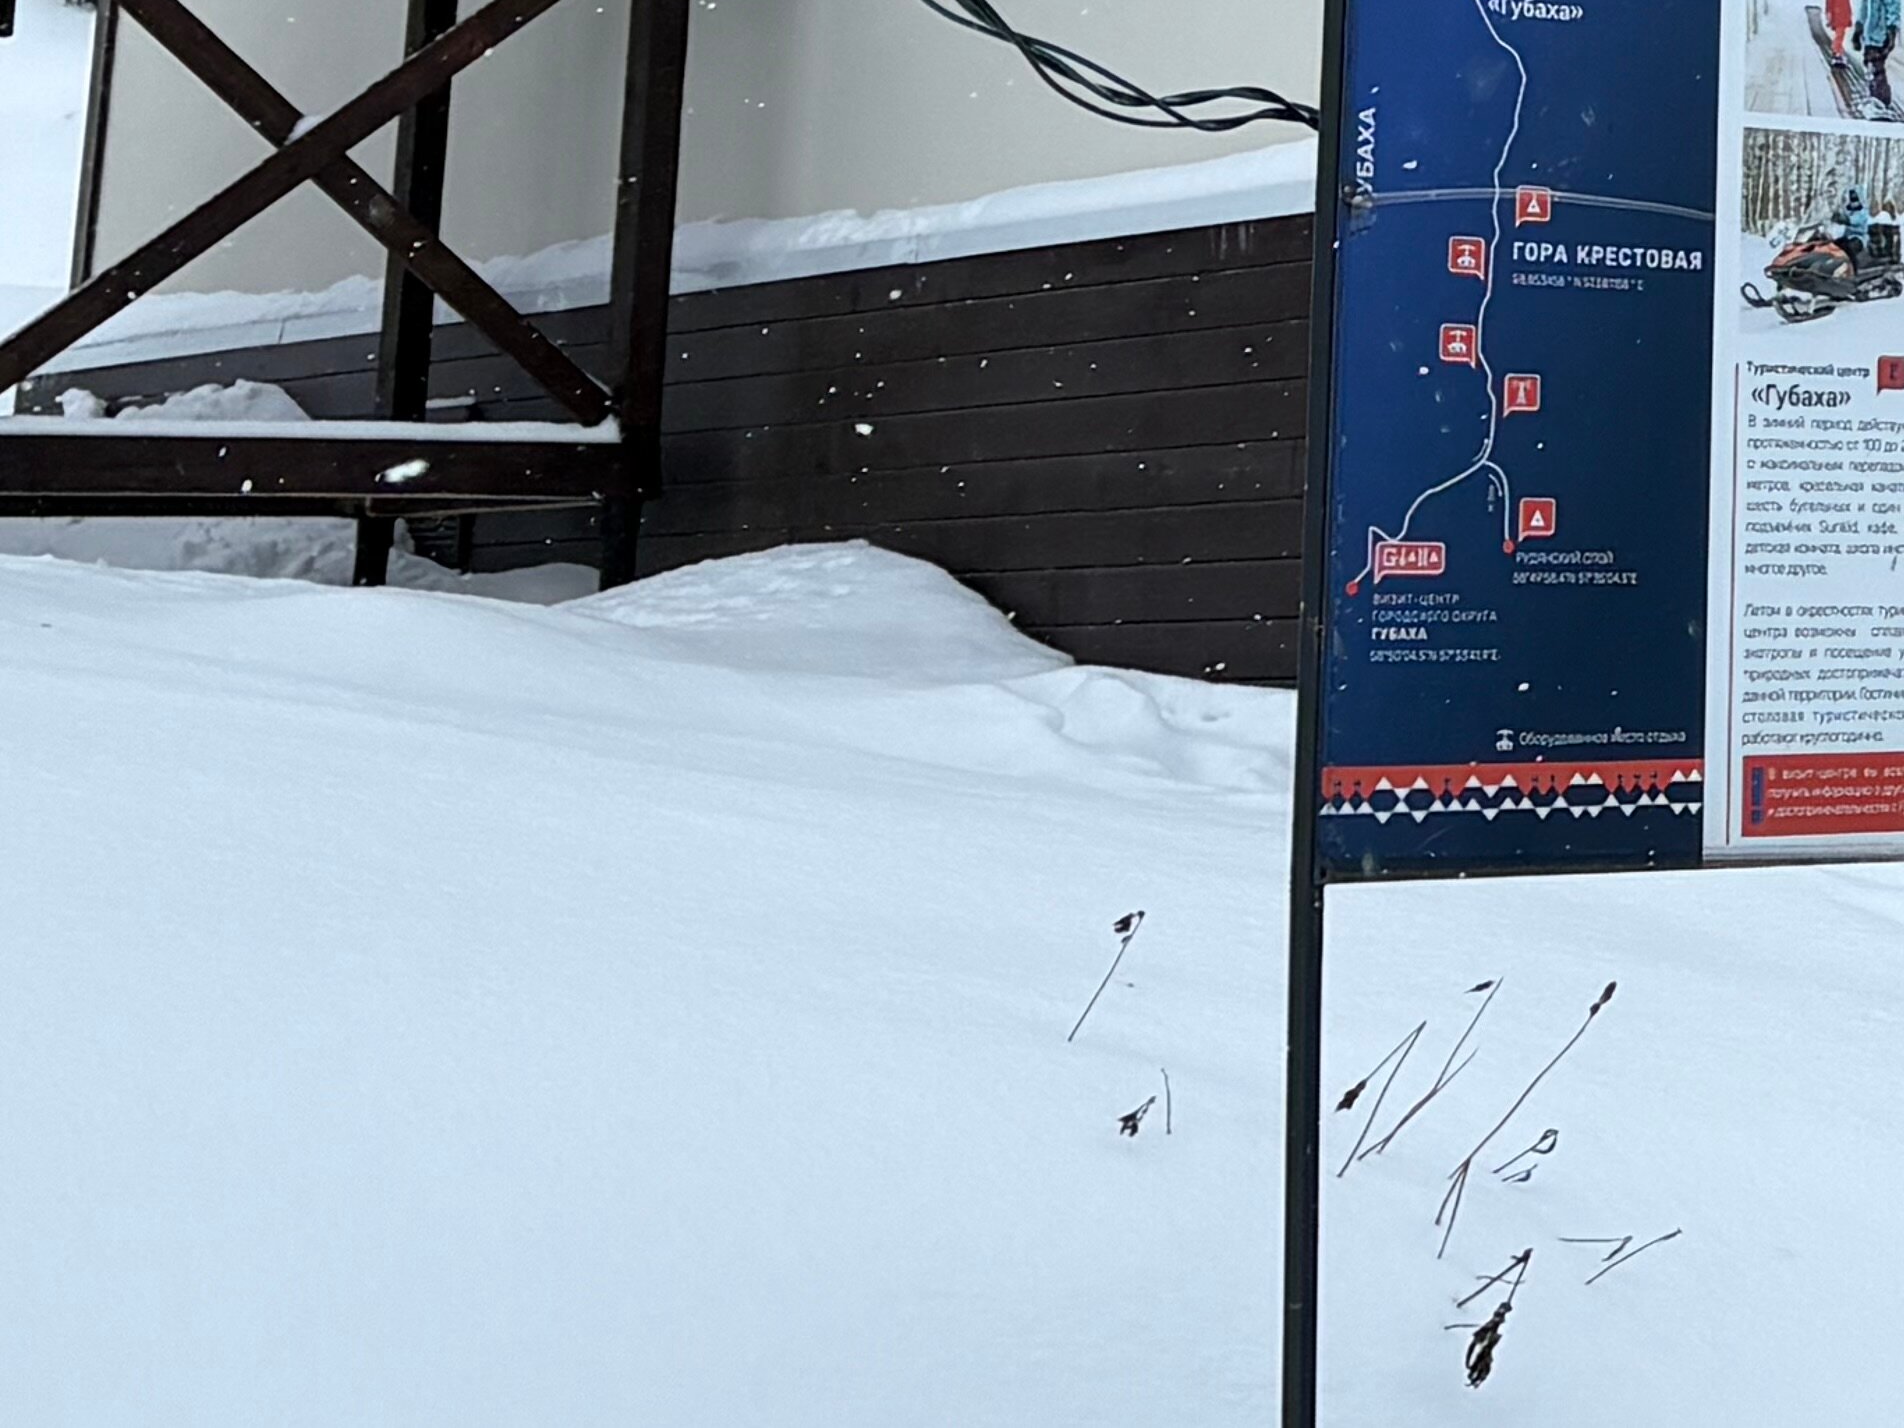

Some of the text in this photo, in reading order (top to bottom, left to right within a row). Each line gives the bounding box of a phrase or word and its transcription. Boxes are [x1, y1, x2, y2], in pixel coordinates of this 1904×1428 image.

[1356, 107, 1376, 196] УБАХА
[1512, 242, 1702, 270] ГОРА КРЕСТОВАЯ
[1747, 361, 1870, 379] Туристический центр
[1751, 384, 1852, 410] «Губаха»
[1372, 593, 1460, 606] ВИЗИТ-ЦЕНТР
[1372, 610, 1498, 623] ГОРОДСКОГО ОКРУГА
[1371, 626, 1428, 640] ГУБАХА
